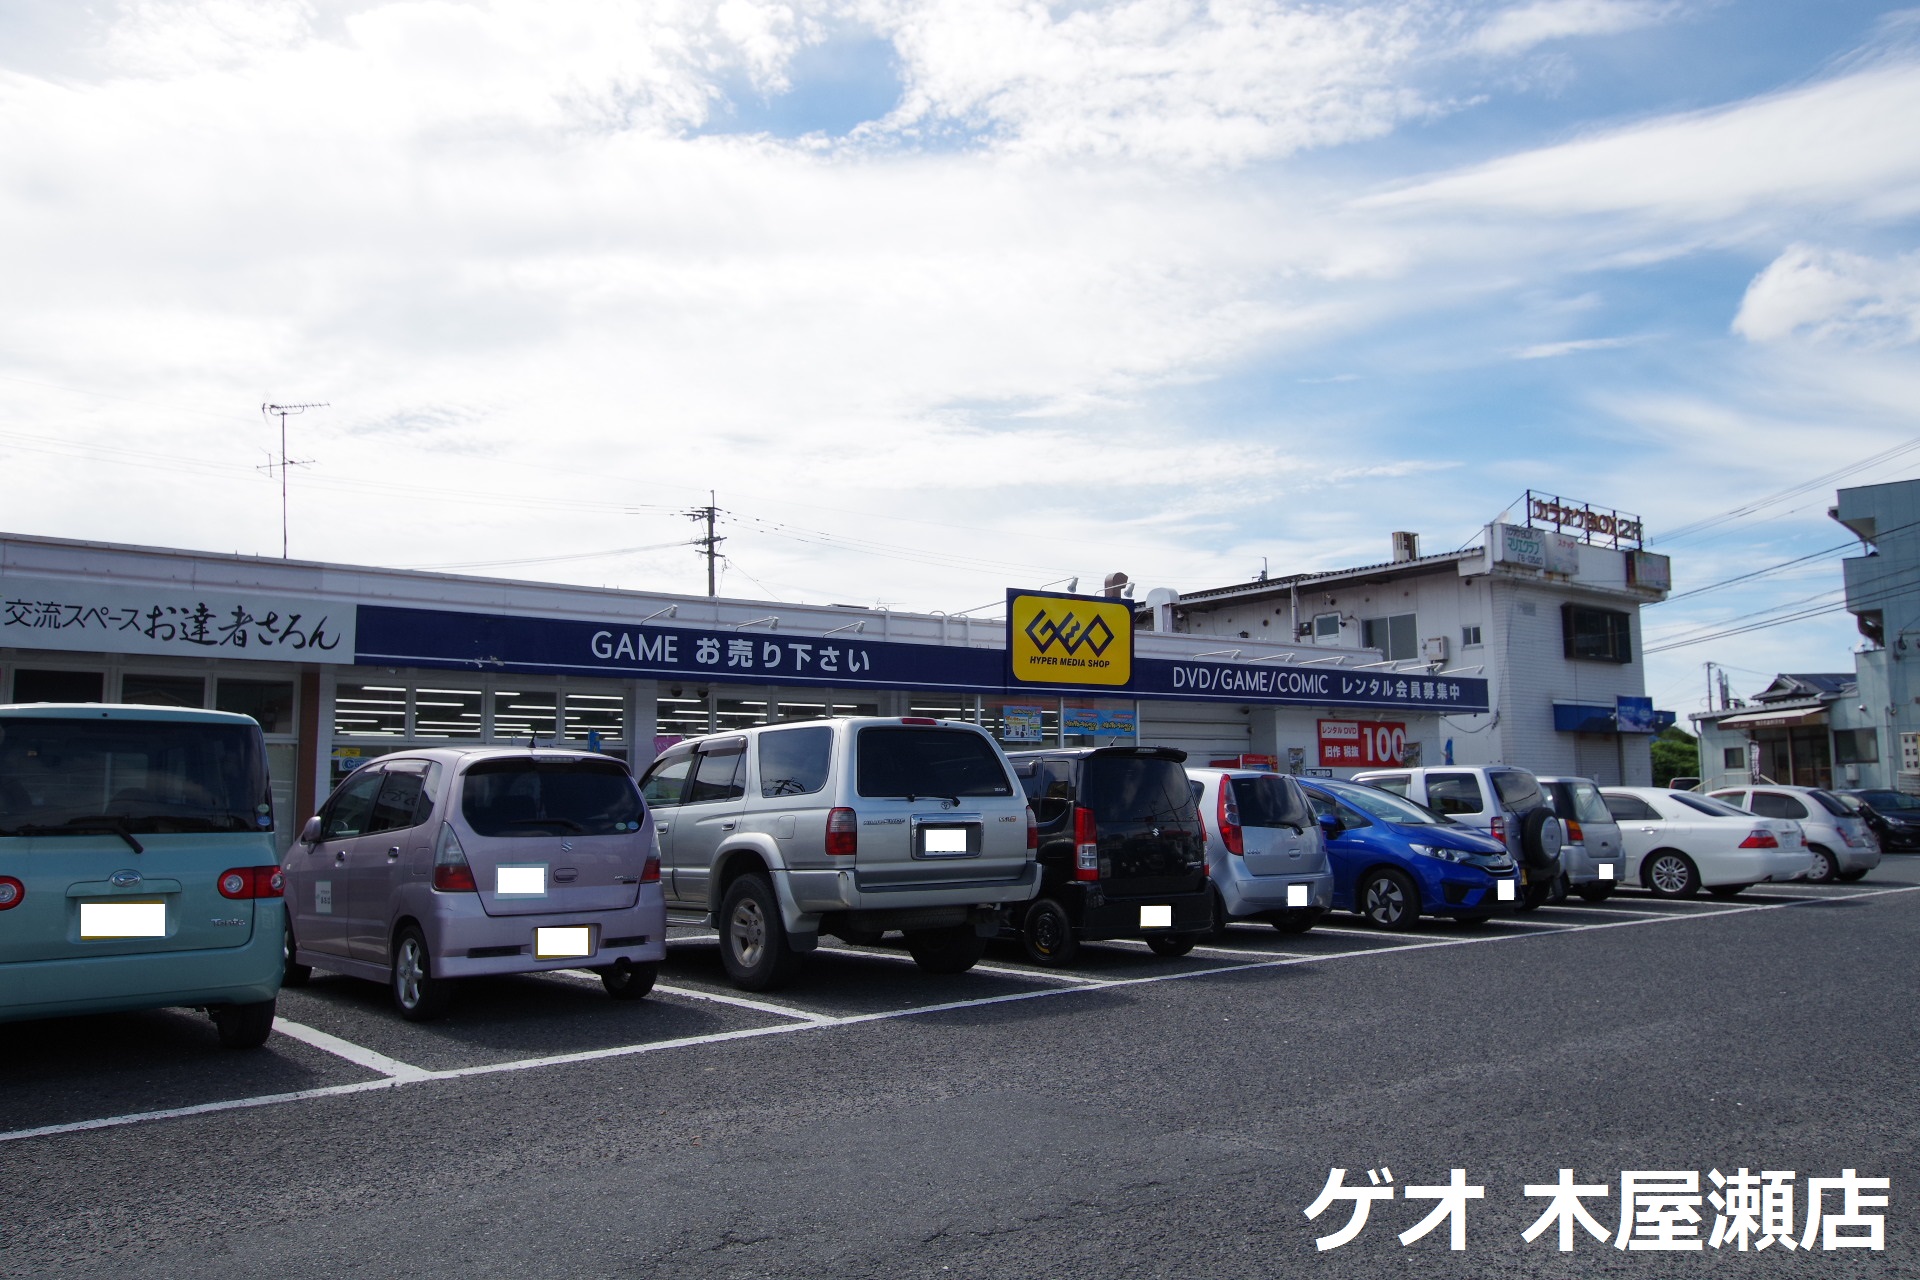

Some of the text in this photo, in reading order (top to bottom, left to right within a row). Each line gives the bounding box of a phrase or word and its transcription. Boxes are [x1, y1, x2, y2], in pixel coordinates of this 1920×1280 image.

[591, 630, 870, 673] GAME お売り下さい
[1030, 656, 1110, 668] HYPER MEDIA SHOP
[1173, 666, 1460, 701] DVD/GAME/COMIC レンタル会員募集中
[1322, 727, 1357, 735] レンタル DVD
[1324, 745, 1341, 758] 旧作
